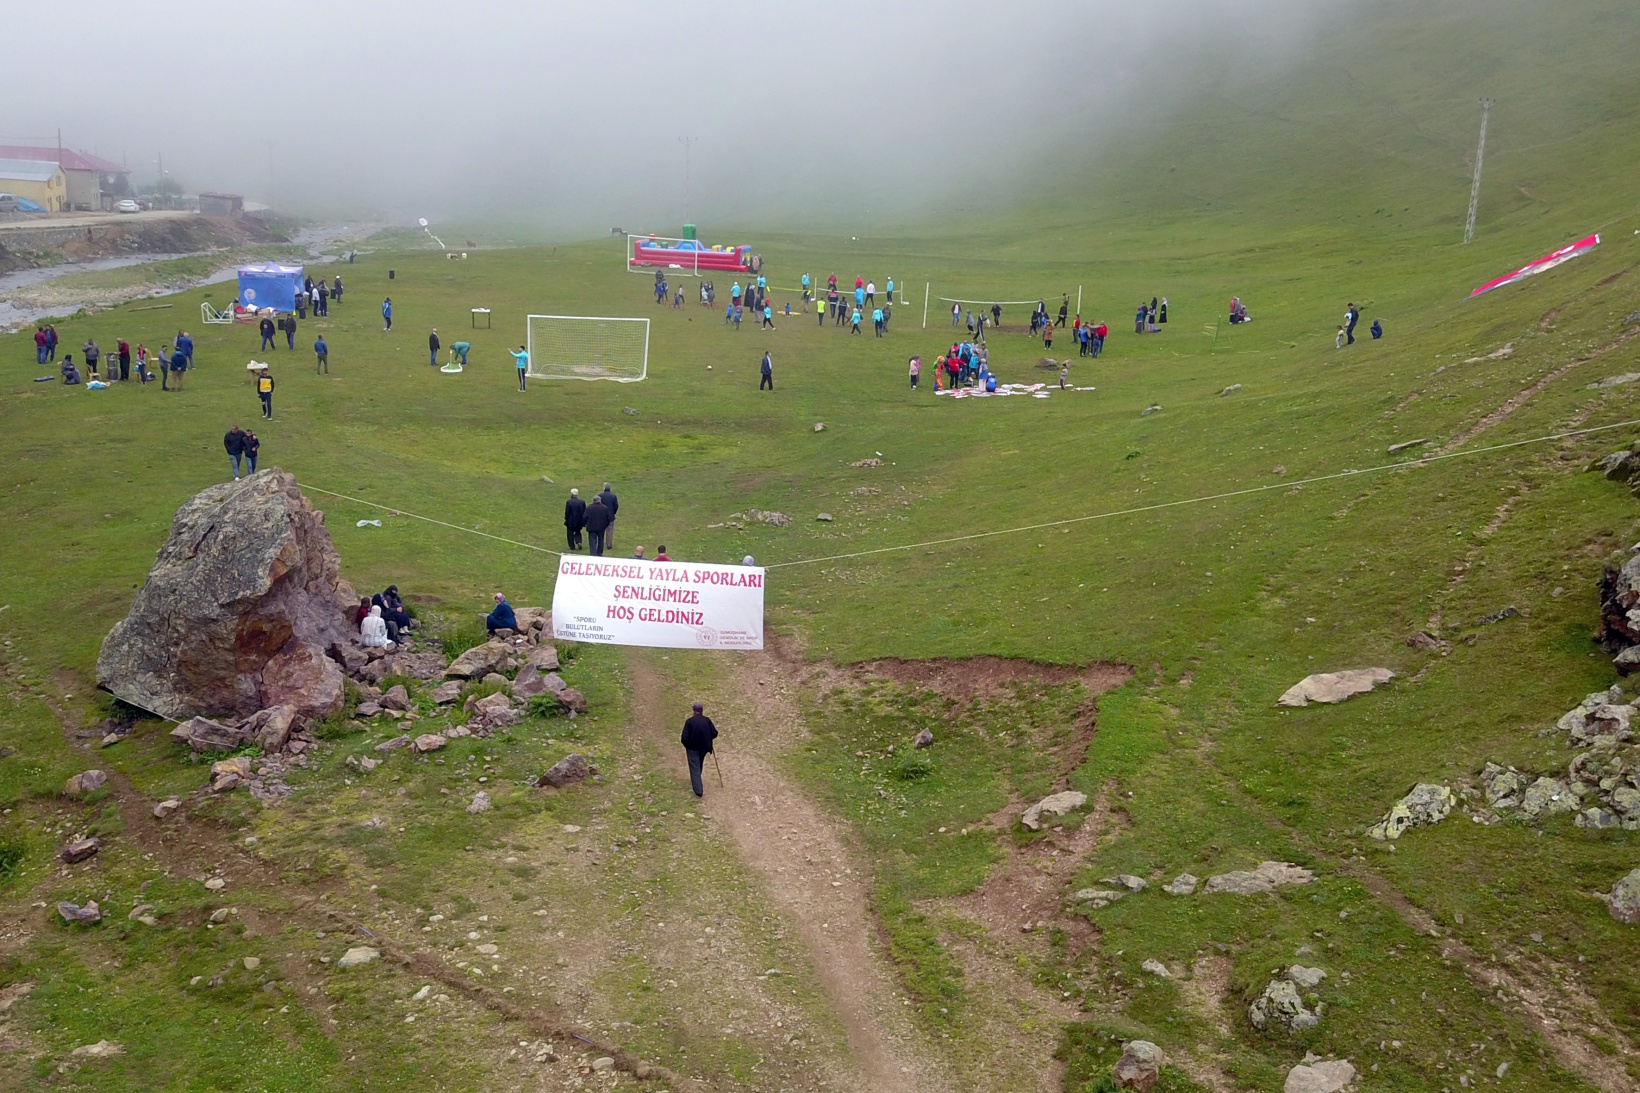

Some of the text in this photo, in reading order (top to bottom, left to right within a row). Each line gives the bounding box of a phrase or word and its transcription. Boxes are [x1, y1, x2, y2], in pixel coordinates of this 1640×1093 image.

[561, 562, 763, 588] GELENEKSEL YAYLA SPORLARI
[613, 584, 700, 605] ŞENLİĞİMİZE
[606, 605, 705, 626] HOŞ GELDİNİZ
[565, 623, 604, 632] BULUTLARIN
